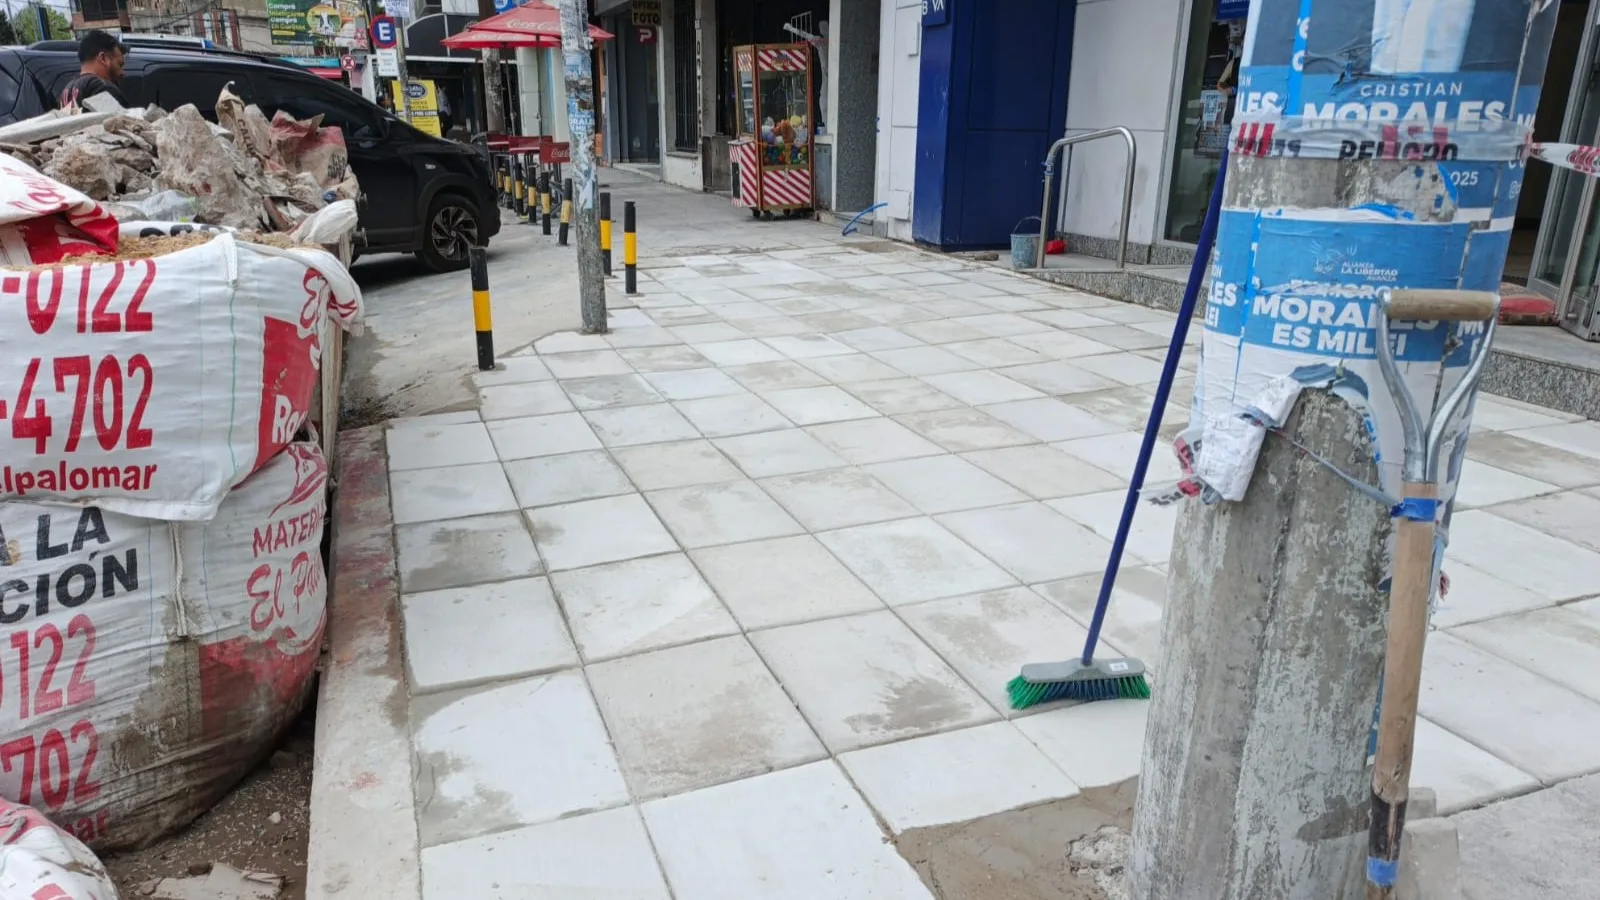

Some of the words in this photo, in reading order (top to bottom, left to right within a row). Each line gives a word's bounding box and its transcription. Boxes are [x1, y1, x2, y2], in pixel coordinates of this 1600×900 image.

[633, 12, 661, 24] FOTO
[378, 22, 391, 41] E
[1360, 82, 1463, 97] CRISTIAN
[1302, 100, 1505, 132] MORALES
[1354, 268, 1399, 277] LIBERTAD
[1272, 322, 1313, 348] ES
[0, 460, 157, 496] lpalomar
[37, 506, 111, 561] LA
[246, 563, 284, 632] El
